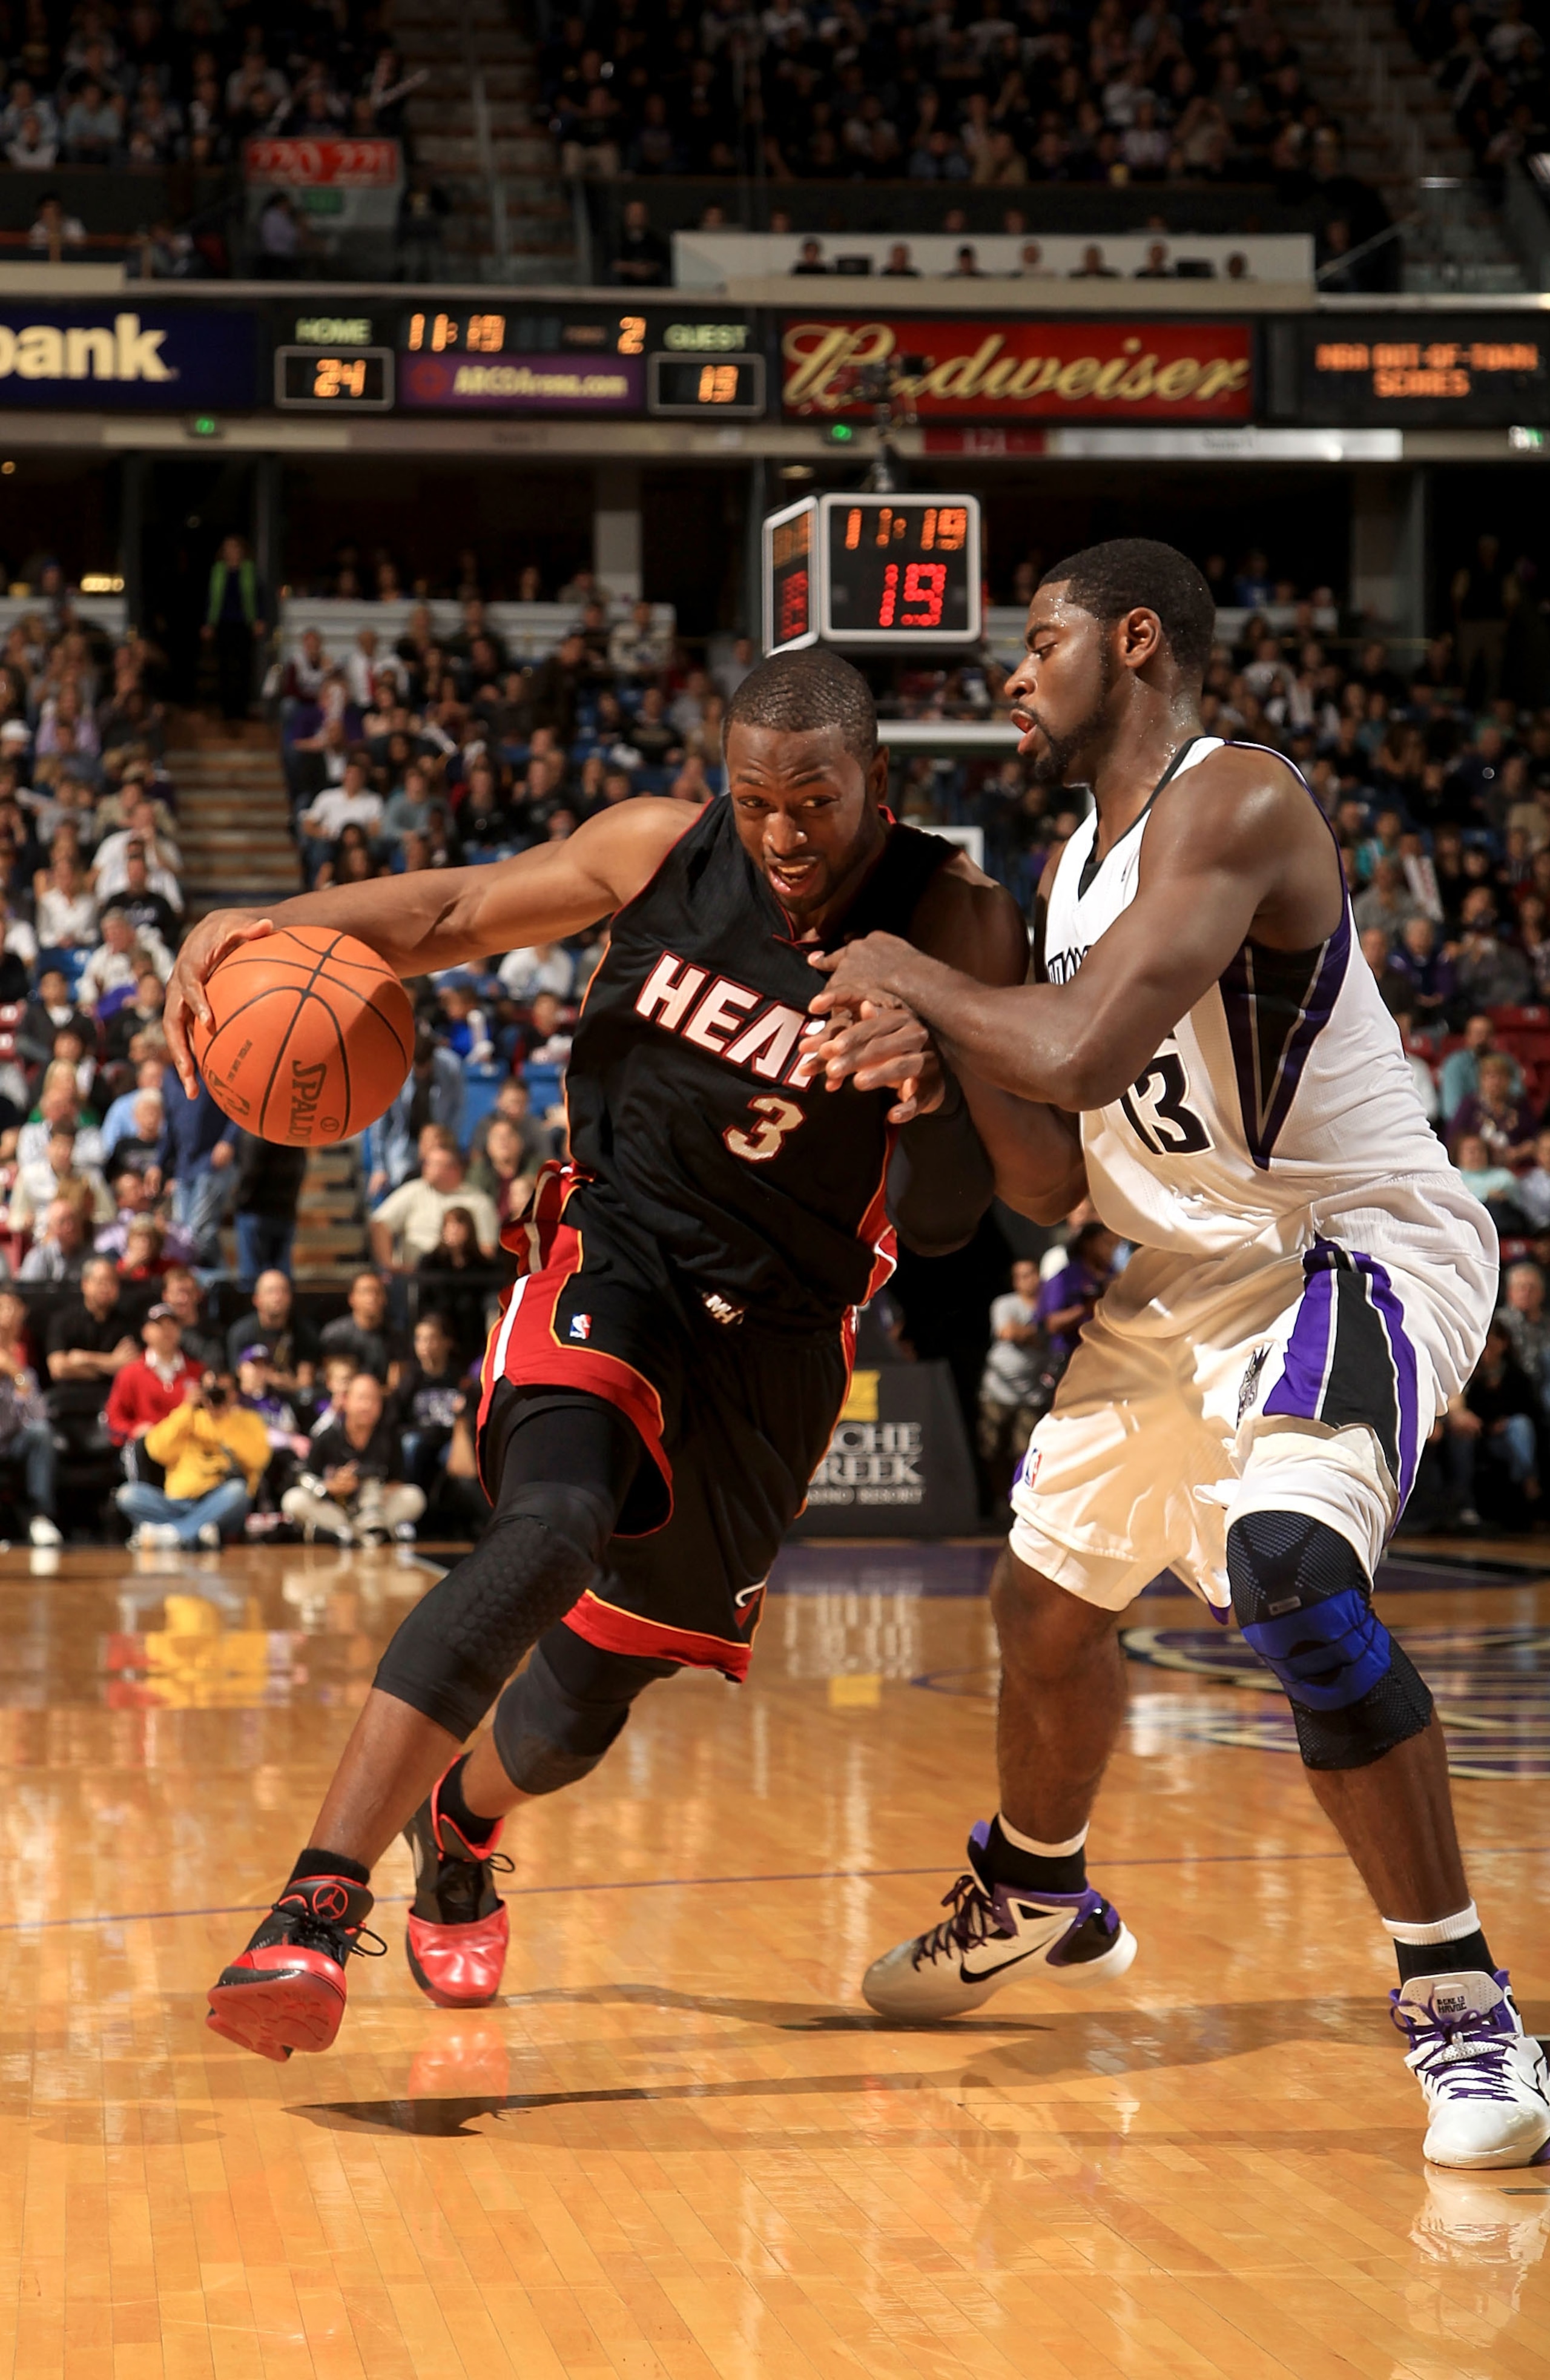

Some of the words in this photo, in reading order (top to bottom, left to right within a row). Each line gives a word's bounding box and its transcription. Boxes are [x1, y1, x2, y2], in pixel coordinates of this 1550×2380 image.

[295, 317, 372, 345] HOME
[617, 316, 647, 354] 2
[664, 323, 750, 351] GUEST
[313, 359, 366, 397] 24
[782, 323, 1250, 405] Bdweiser
[845, 507, 968, 550] 11:19
[879, 563, 947, 627] 19
[722, 1094, 806, 1163] 3
[828, 1422, 923, 1455] CHE
[809, 1455, 925, 1485] REEK
